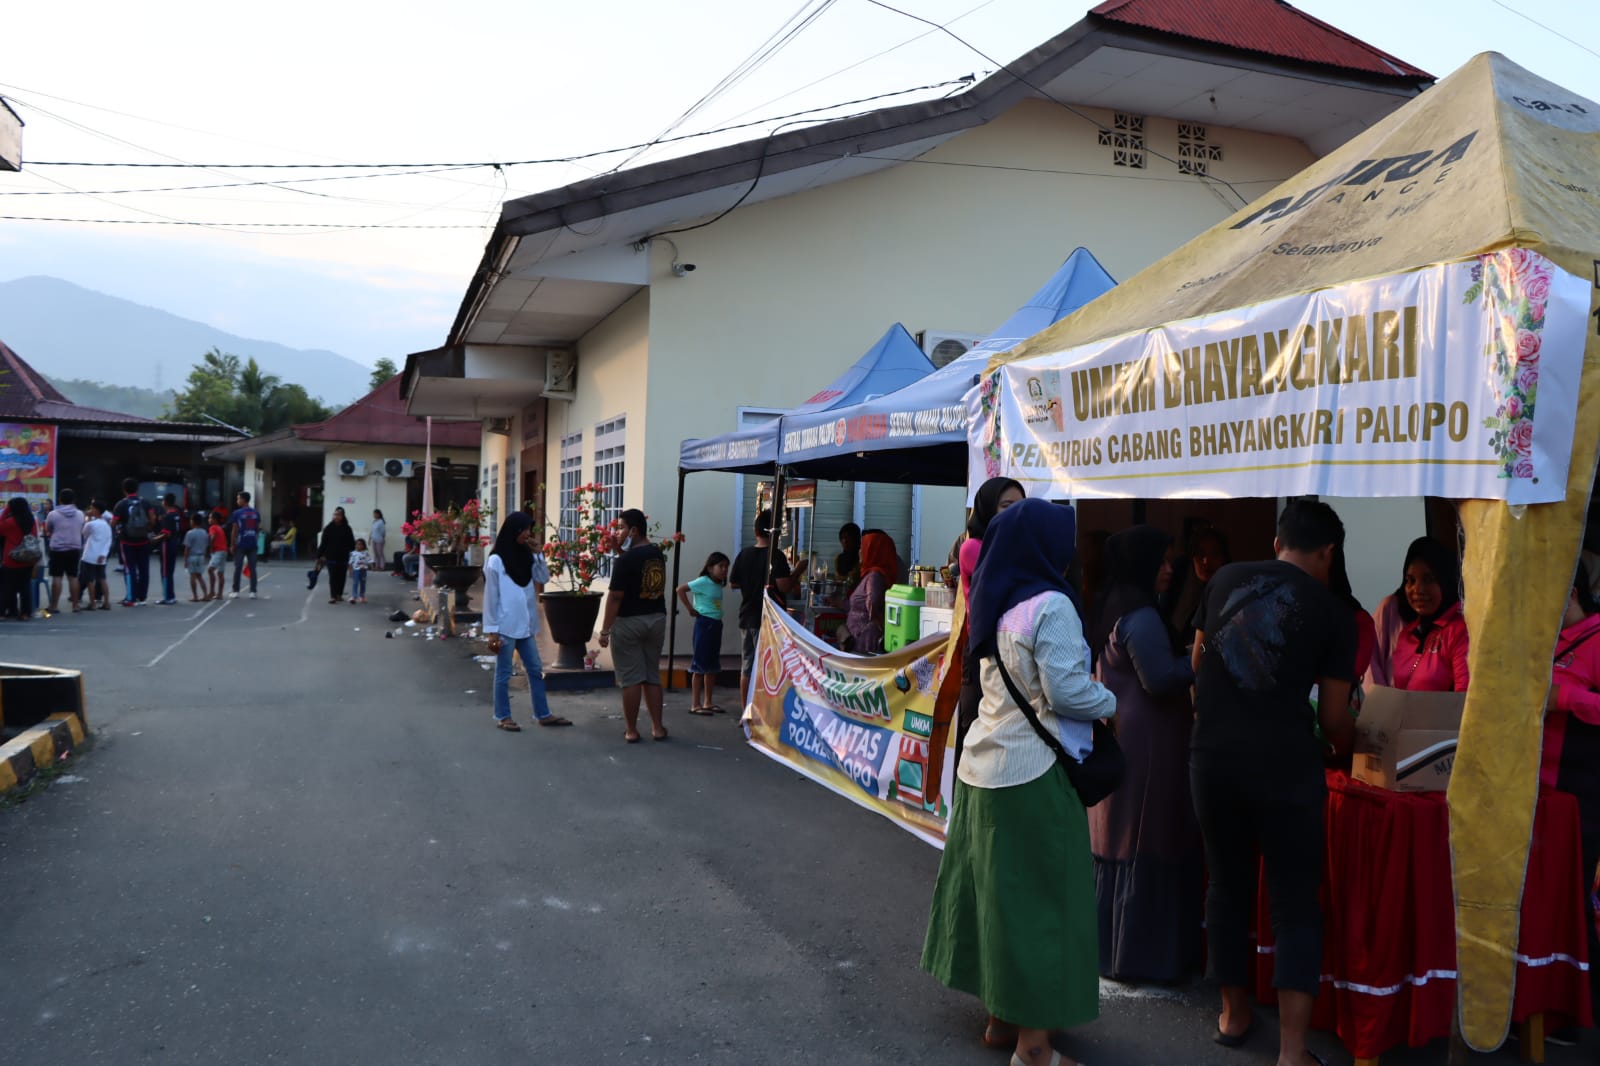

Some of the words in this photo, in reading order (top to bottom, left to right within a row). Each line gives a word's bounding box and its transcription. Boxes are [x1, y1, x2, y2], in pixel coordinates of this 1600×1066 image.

[1272, 236, 1383, 256] Selamanya
[1071, 357, 1156, 422] UMKM
[1164, 306, 1417, 409] BHAYANGKARI
[1010, 436, 1101, 467] PENGURUS
[1107, 427, 1182, 464] CABANG
[1356, 401, 1469, 444] PALOPO
[791, 696, 882, 761] SALANTAS
[911, 716, 930, 732] UMKM
